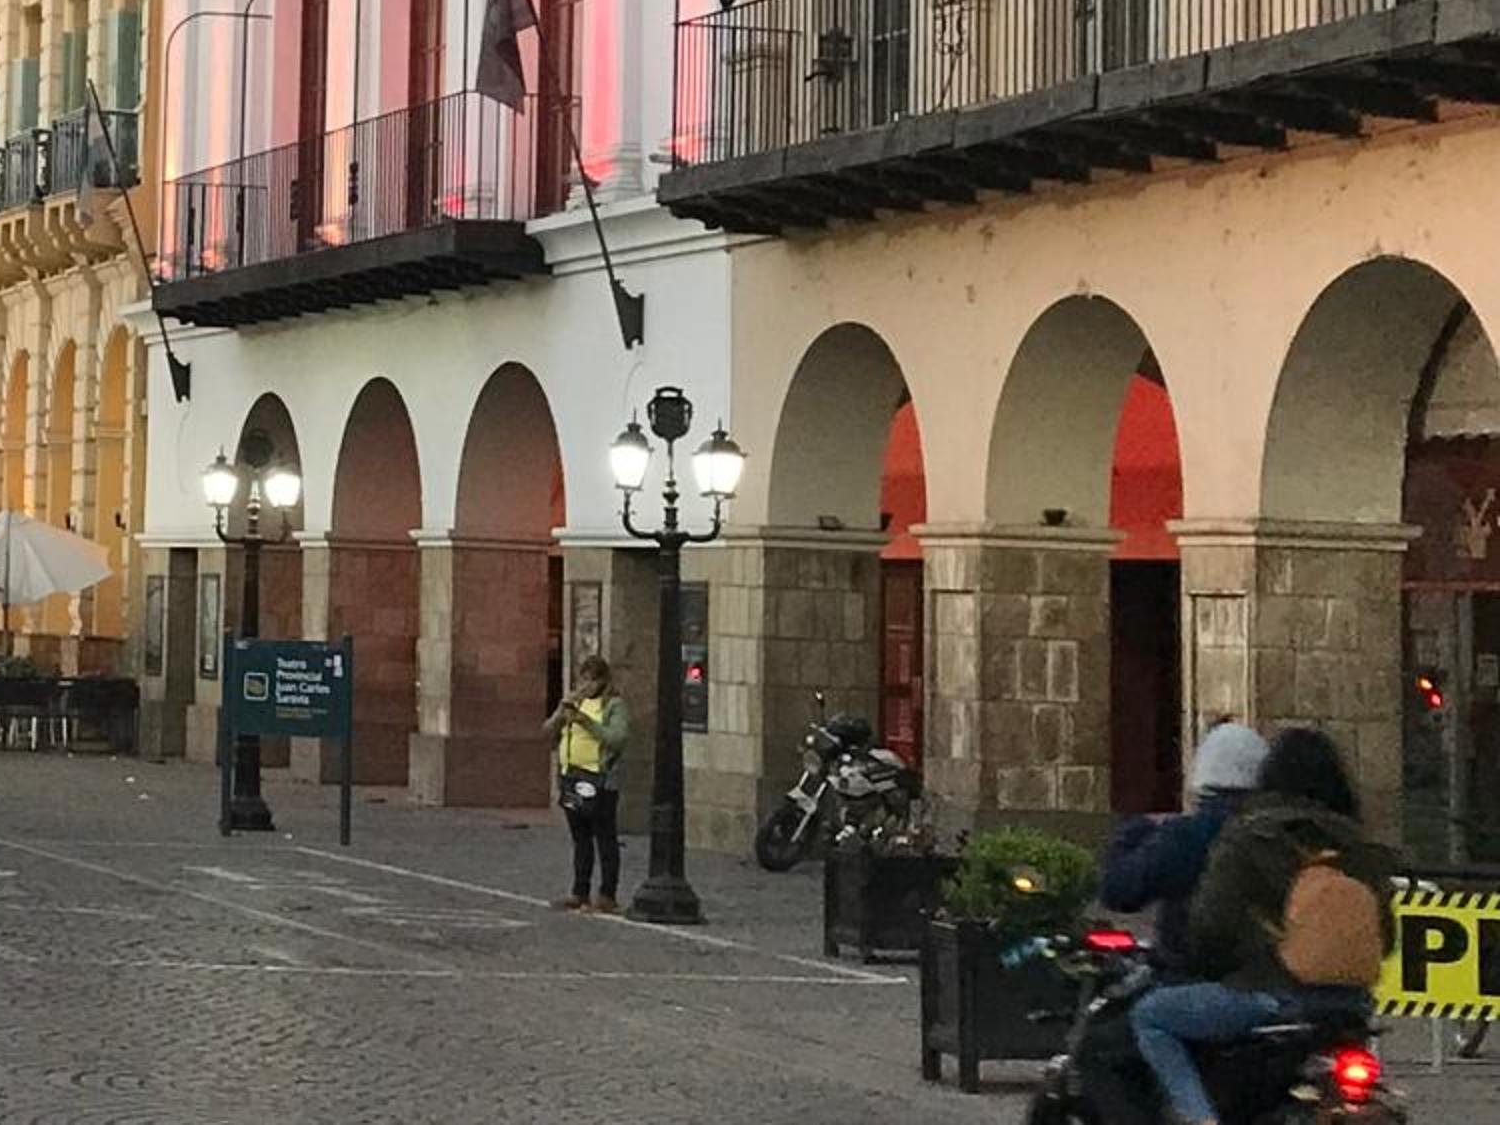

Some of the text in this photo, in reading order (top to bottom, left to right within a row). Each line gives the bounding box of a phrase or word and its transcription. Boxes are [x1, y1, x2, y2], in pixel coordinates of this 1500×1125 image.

[276, 657, 307, 669] Teatro
[276, 669, 323, 682] Provincial
[275, 681, 331, 694] Juan Carlos
